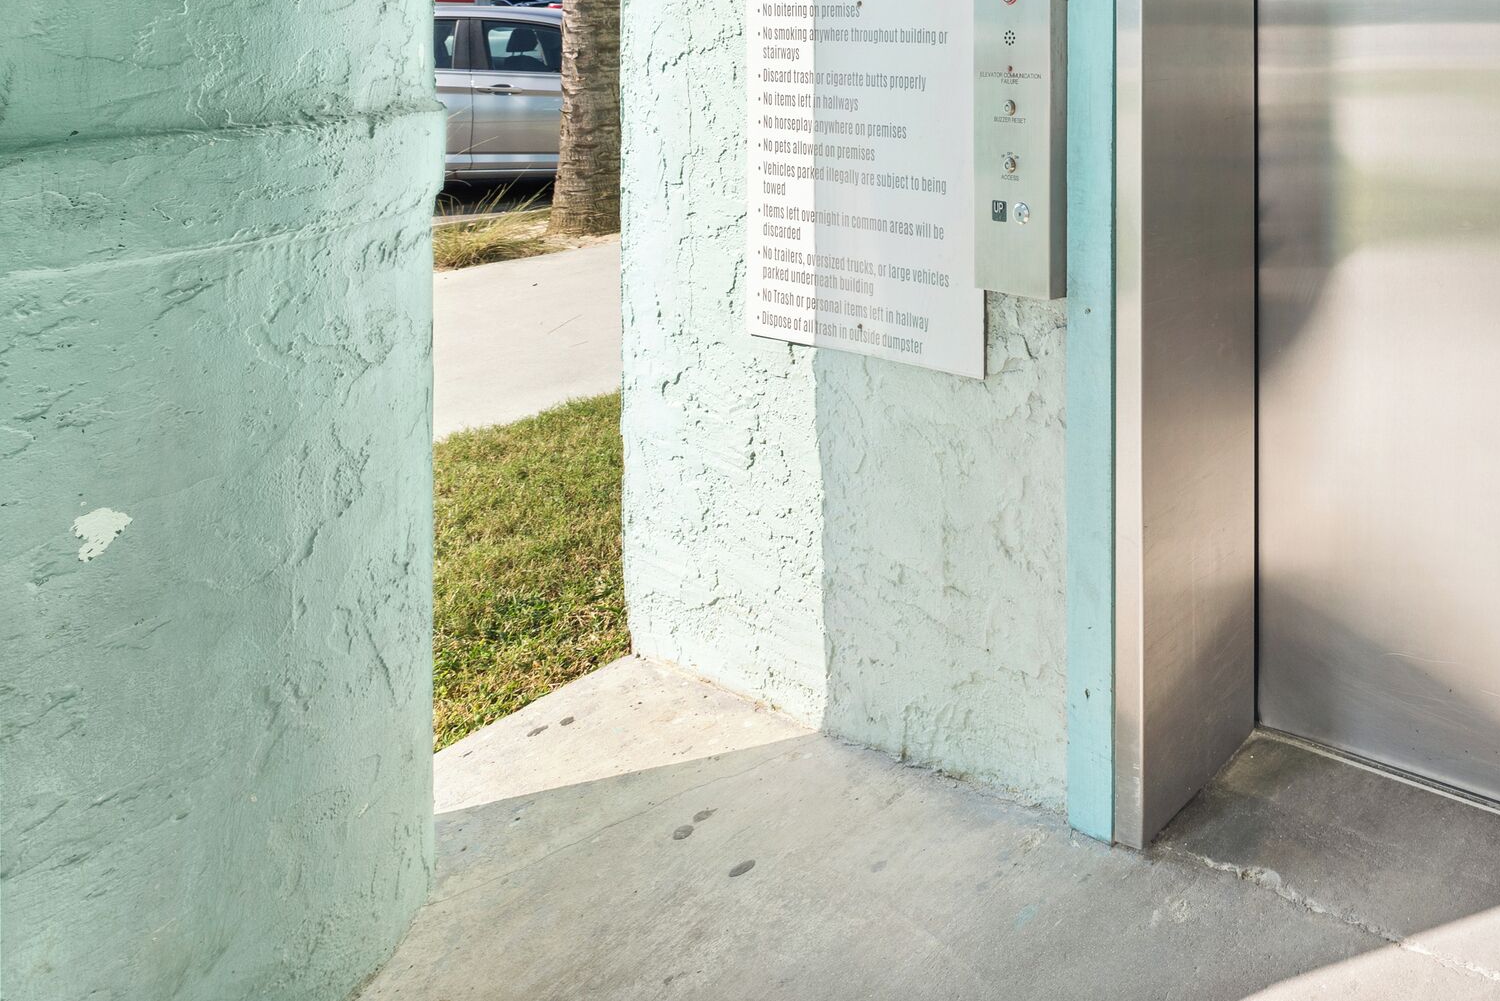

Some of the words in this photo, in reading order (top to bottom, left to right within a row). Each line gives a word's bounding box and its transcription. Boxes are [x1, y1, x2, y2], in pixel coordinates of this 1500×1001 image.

[763, 4, 772, 17] No
[774, 3, 807, 18] loitering
[809, 5, 819, 17] on
[822, 3, 860, 19] premises
[763, 26, 772, 40] No
[774, 27, 807, 42] smoking
[809, 27, 849, 43] anywhere
[851, 28, 898, 44] throughout
[900, 28, 936, 45] building
[939, 30, 948, 44] or
[763, 45, 800, 61] stairways
[763, 68, 791, 83] Discard
[793, 69, 813, 84] trash
[816, 72, 824, 84] or
[826, 71, 864, 87] cigarette
[866, 72, 888, 88] butts
[890, 73, 926, 91] properly
[763, 92, 772, 105] No
[774, 92, 796, 107] items
[798, 93, 811, 107] left
[813, 94, 820, 108] in
[823, 94, 859, 112] hallways
[764, 115, 773, 129] No
[775, 116, 812, 133] horseplay
[814, 119, 853, 135] anywhere
[855, 123, 865, 135] on
[868, 122, 907, 139] premises
[764, 138, 773, 152] No
[775, 141, 791, 154] pets
[793, 140, 823, 157] allowed
[825, 145, 835, 157] on
[837, 144, 875, 161] premises
[763, 161, 795, 178] Vehicles
[797, 165, 824, 180] parked
[826, 166, 859, 185] illegally
[861, 171, 874, 185] are
[877, 172, 908, 190] subject
[911, 178, 919, 190] to
[921, 177, 946, 195] being
[763, 180, 785, 195] towed
[994, 201, 1004, 213] UP
[763, 204, 784, 219] Items
[786, 205, 799, 221] left
[802, 209, 840, 227] overnight
[842, 213, 850, 227] in
[851, 215, 887, 232] common
[890, 221, 913, 236] areas
[916, 223, 931, 238] will
[933, 224, 944, 240] be
[763, 222, 800, 240] discarded
[763, 246, 772, 259] No
[774, 247, 805, 267] trailers,
[807, 253, 845, 270] oversized
[847, 257, 876, 276] trucks,
[878, 263, 887, 276] or
[889, 264, 910, 282] large
[913, 269, 950, 288] vehicles
[763, 266, 788, 281] parked
[791, 269, 837, 289] underneath
[840, 276, 874, 296] building
[763, 288, 772, 302] No
[774, 290, 794, 305] Trash
[796, 294, 804, 306] or
[806, 294, 842, 313] personal
[844, 301, 868, 319] items
[870, 305, 883, 322] left
[886, 307, 893, 322] in
[896, 309, 929, 332] hallway
[762, 311, 791, 330] Dispose
[794, 316, 802, 330] of
[804, 319, 813, 333] all
[815, 321, 837, 337] trash
[839, 324, 847, 338] in
[849, 326, 880, 345] outside
[882, 332, 923, 354] dumpster
